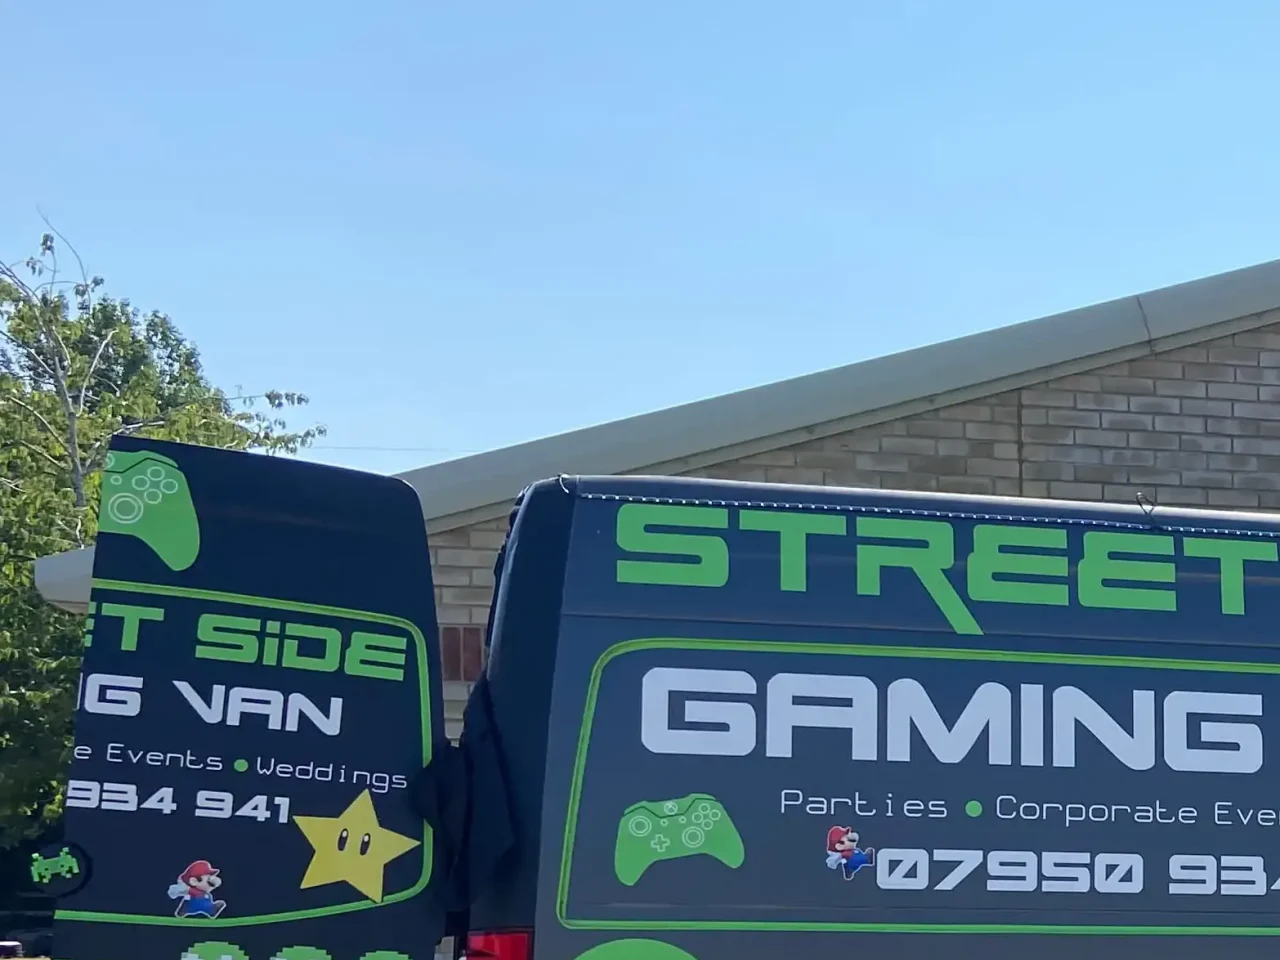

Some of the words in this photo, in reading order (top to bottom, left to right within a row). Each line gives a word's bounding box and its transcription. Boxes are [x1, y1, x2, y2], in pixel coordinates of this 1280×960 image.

[616, 502, 1279, 635] STREET
[83, 602, 165, 651] T
[76, 672, 144, 717] G
[172, 679, 343, 736] VAN
[640, 666, 1263, 775] GAMING
[106, 743, 223, 771] Events
[256, 756, 408, 793] Weddings
[65, 779, 177, 814] 934
[194, 790, 291, 824] 941
[780, 789, 948, 818] Parties
[995, 795, 1198, 827] Corporate
[876, 847, 1144, 894] 07950
